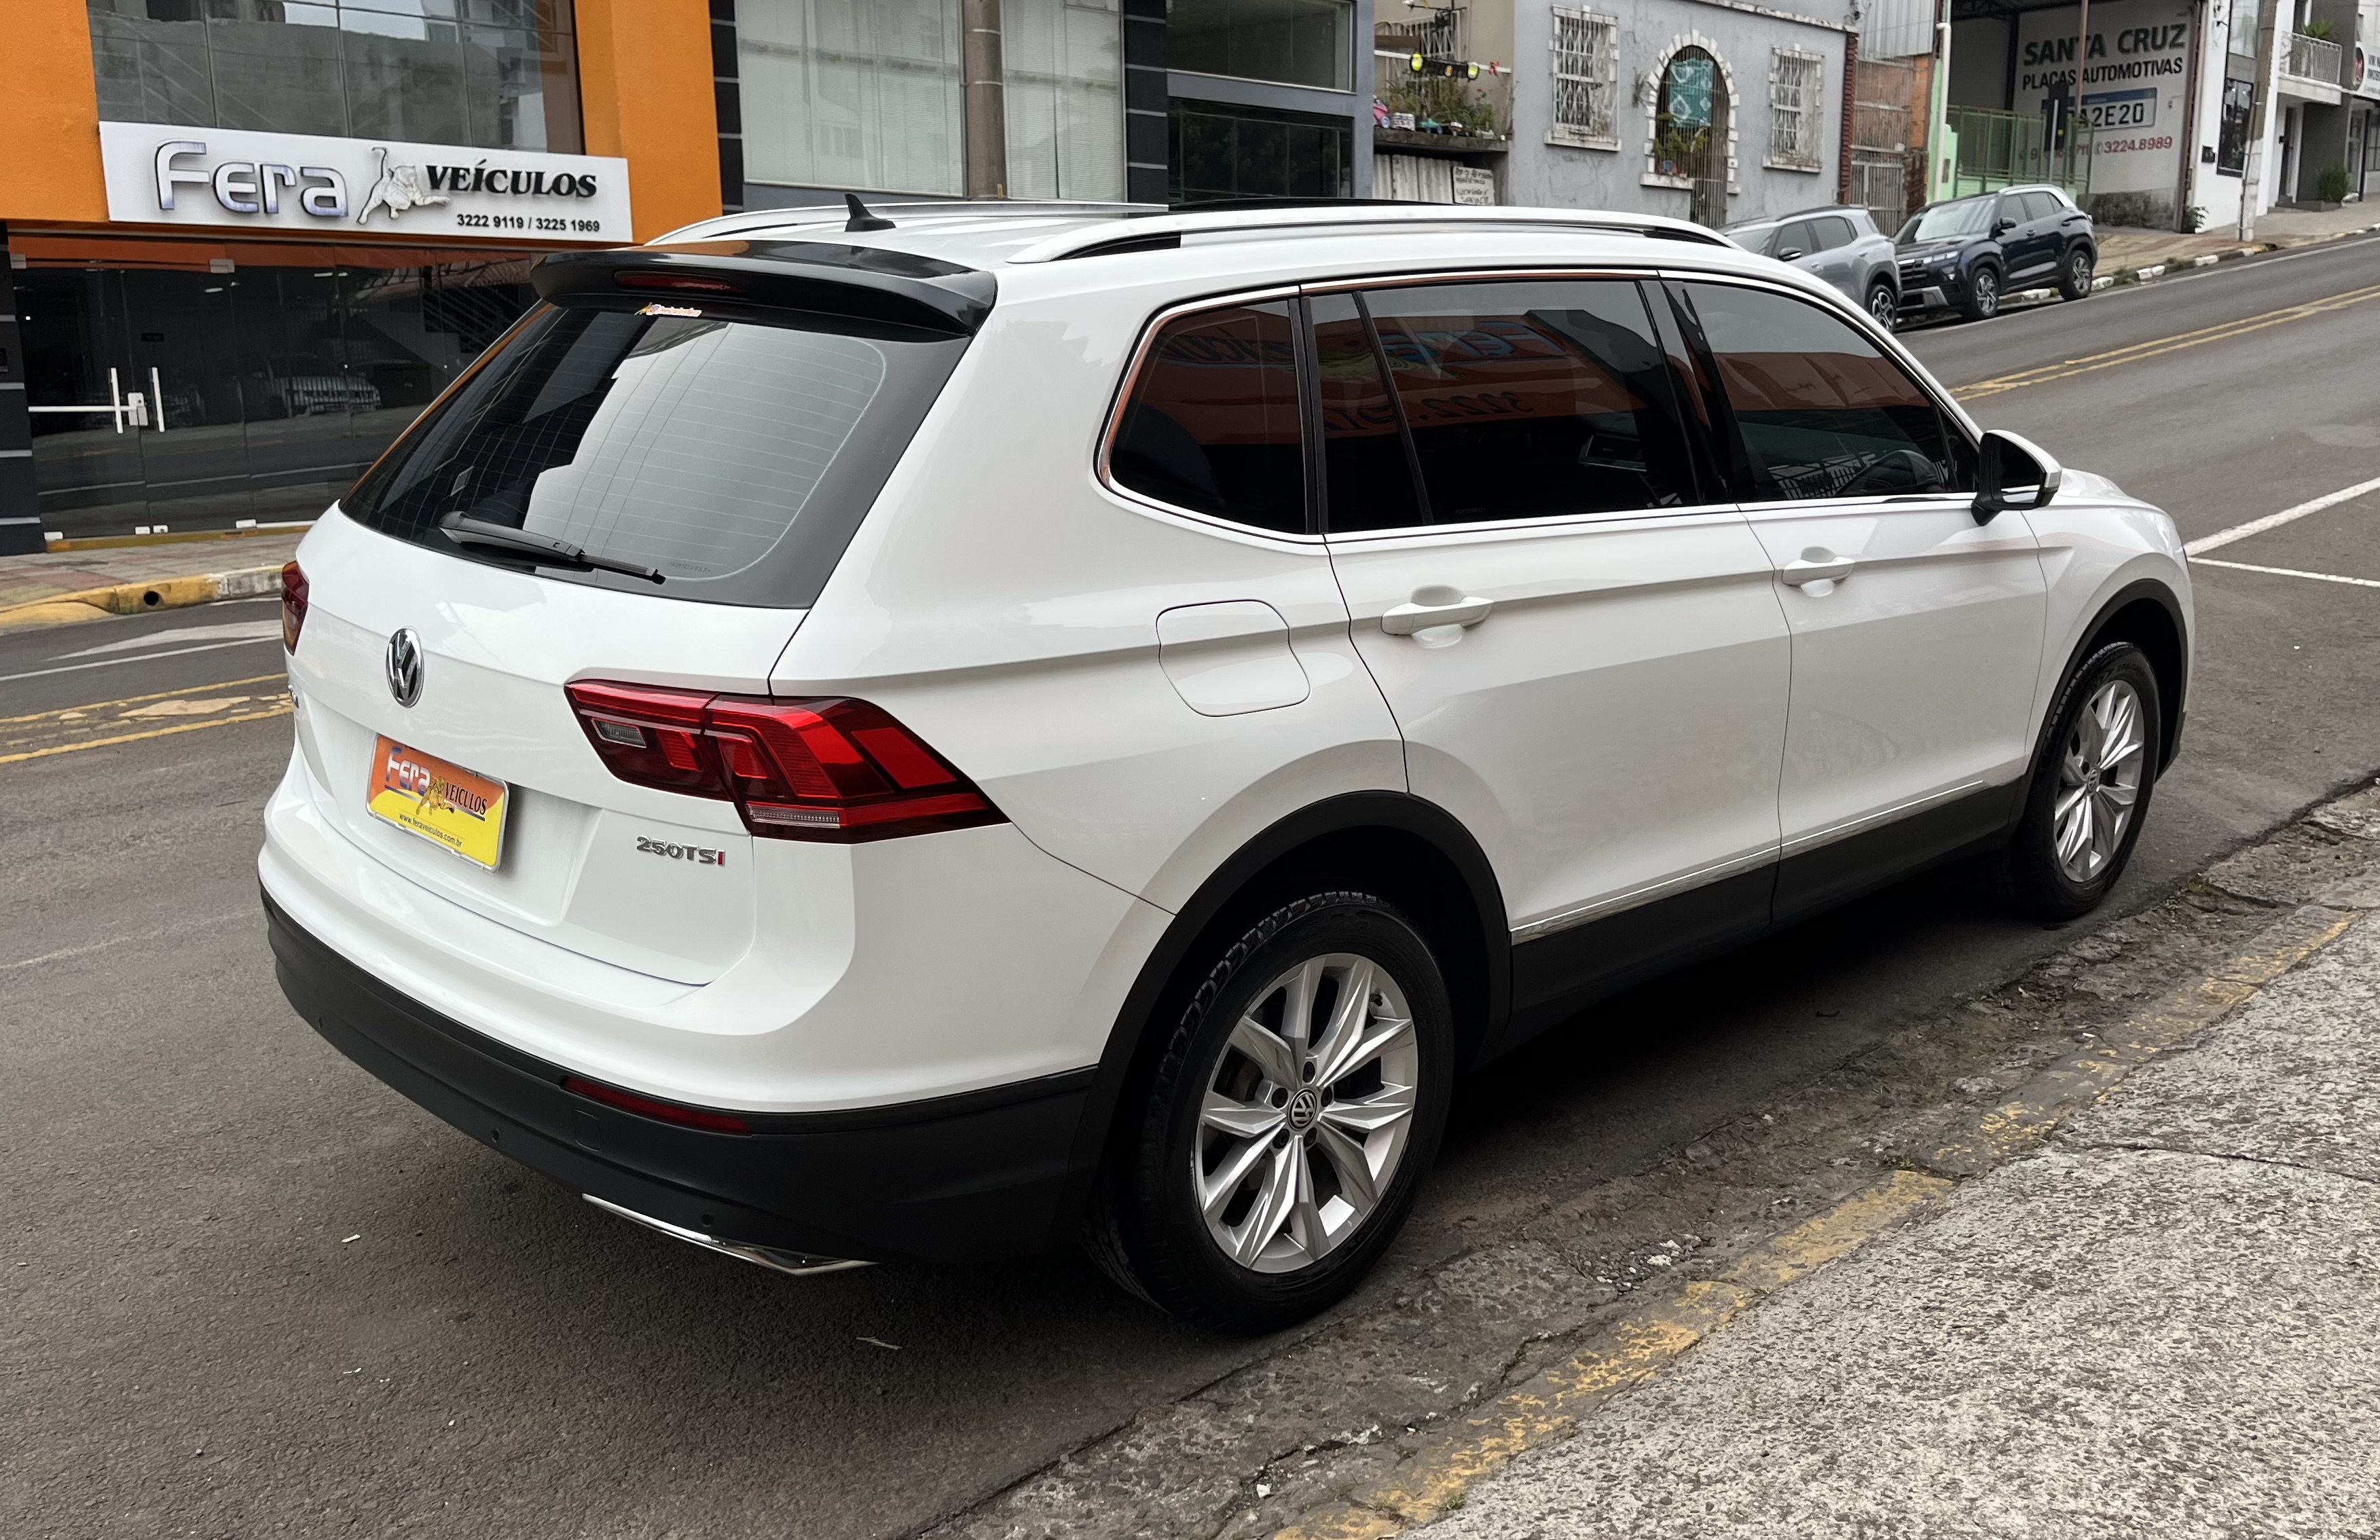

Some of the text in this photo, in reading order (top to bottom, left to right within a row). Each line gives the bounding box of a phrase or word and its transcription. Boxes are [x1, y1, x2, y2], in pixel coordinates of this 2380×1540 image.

[2117, 23, 2187, 55] CRUZ
[2023, 57, 2183, 90] PLACAS AUTOMOTIVAS
[2104, 136, 2173, 155] 3224.8989
[153, 139, 598, 218] Fera VEÍCULOS
[456, 214, 490, 227] 3222
[494, 215, 524, 229] 9119
[536, 217, 566, 231] 3225
[570, 219, 600, 232] 1969
[385, 745, 431, 797] Fera
[399, 812, 462, 848] www.feraveiculos.com.br
[636, 835, 726, 866] 250TSI
